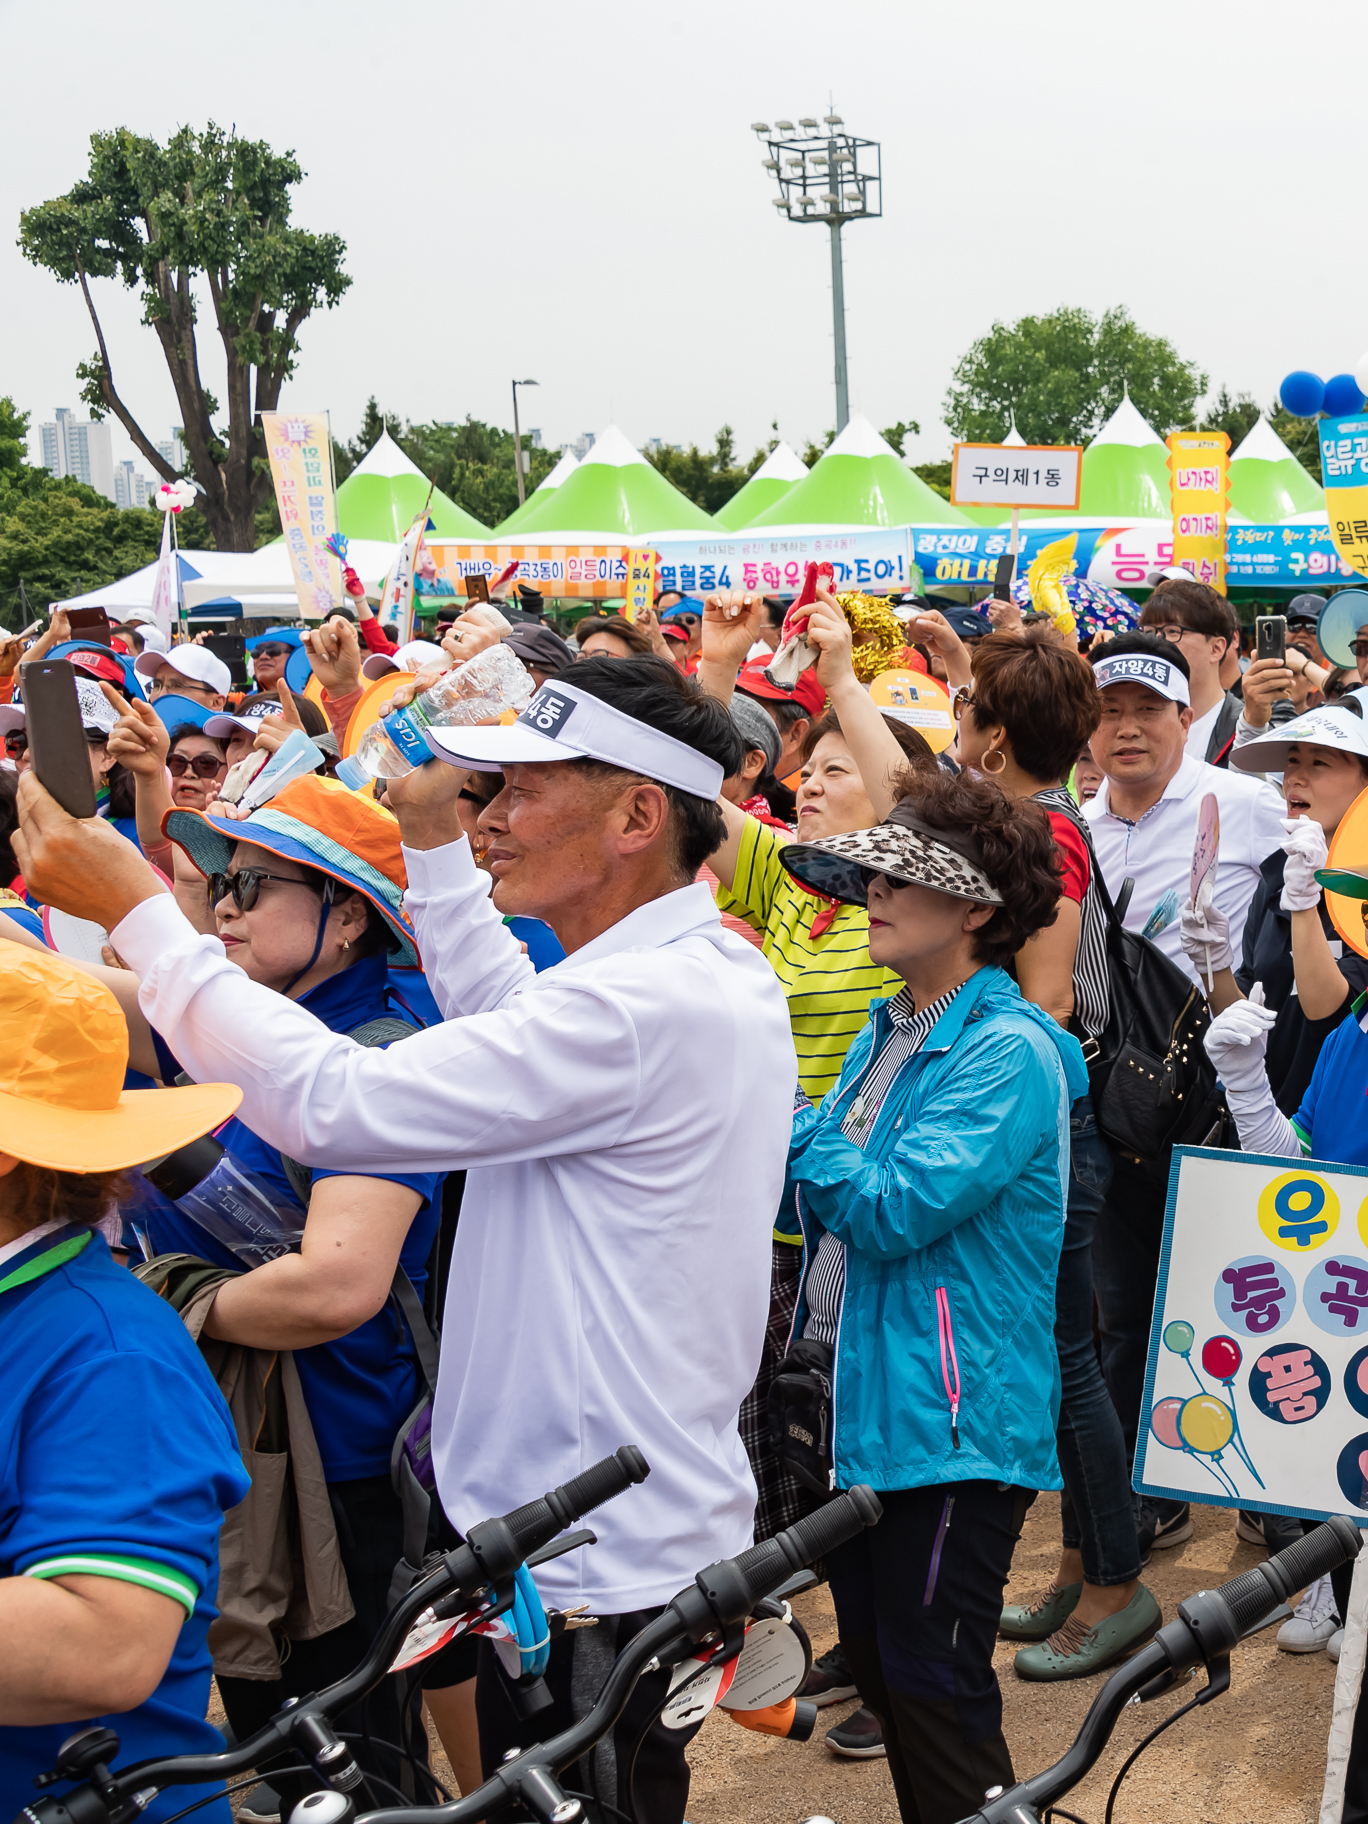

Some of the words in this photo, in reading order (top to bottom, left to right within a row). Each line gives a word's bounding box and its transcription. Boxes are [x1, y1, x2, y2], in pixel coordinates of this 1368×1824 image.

[972, 466, 1062, 488] 구의제1동
[917, 534, 978, 553] 광진의
[569, 559, 627, 581] 일등이쥬
[660, 565, 731, 591] 열혈중4
[834, 555, 904, 584] 가즈아!
[1112, 660, 1167, 682] 자양4동
